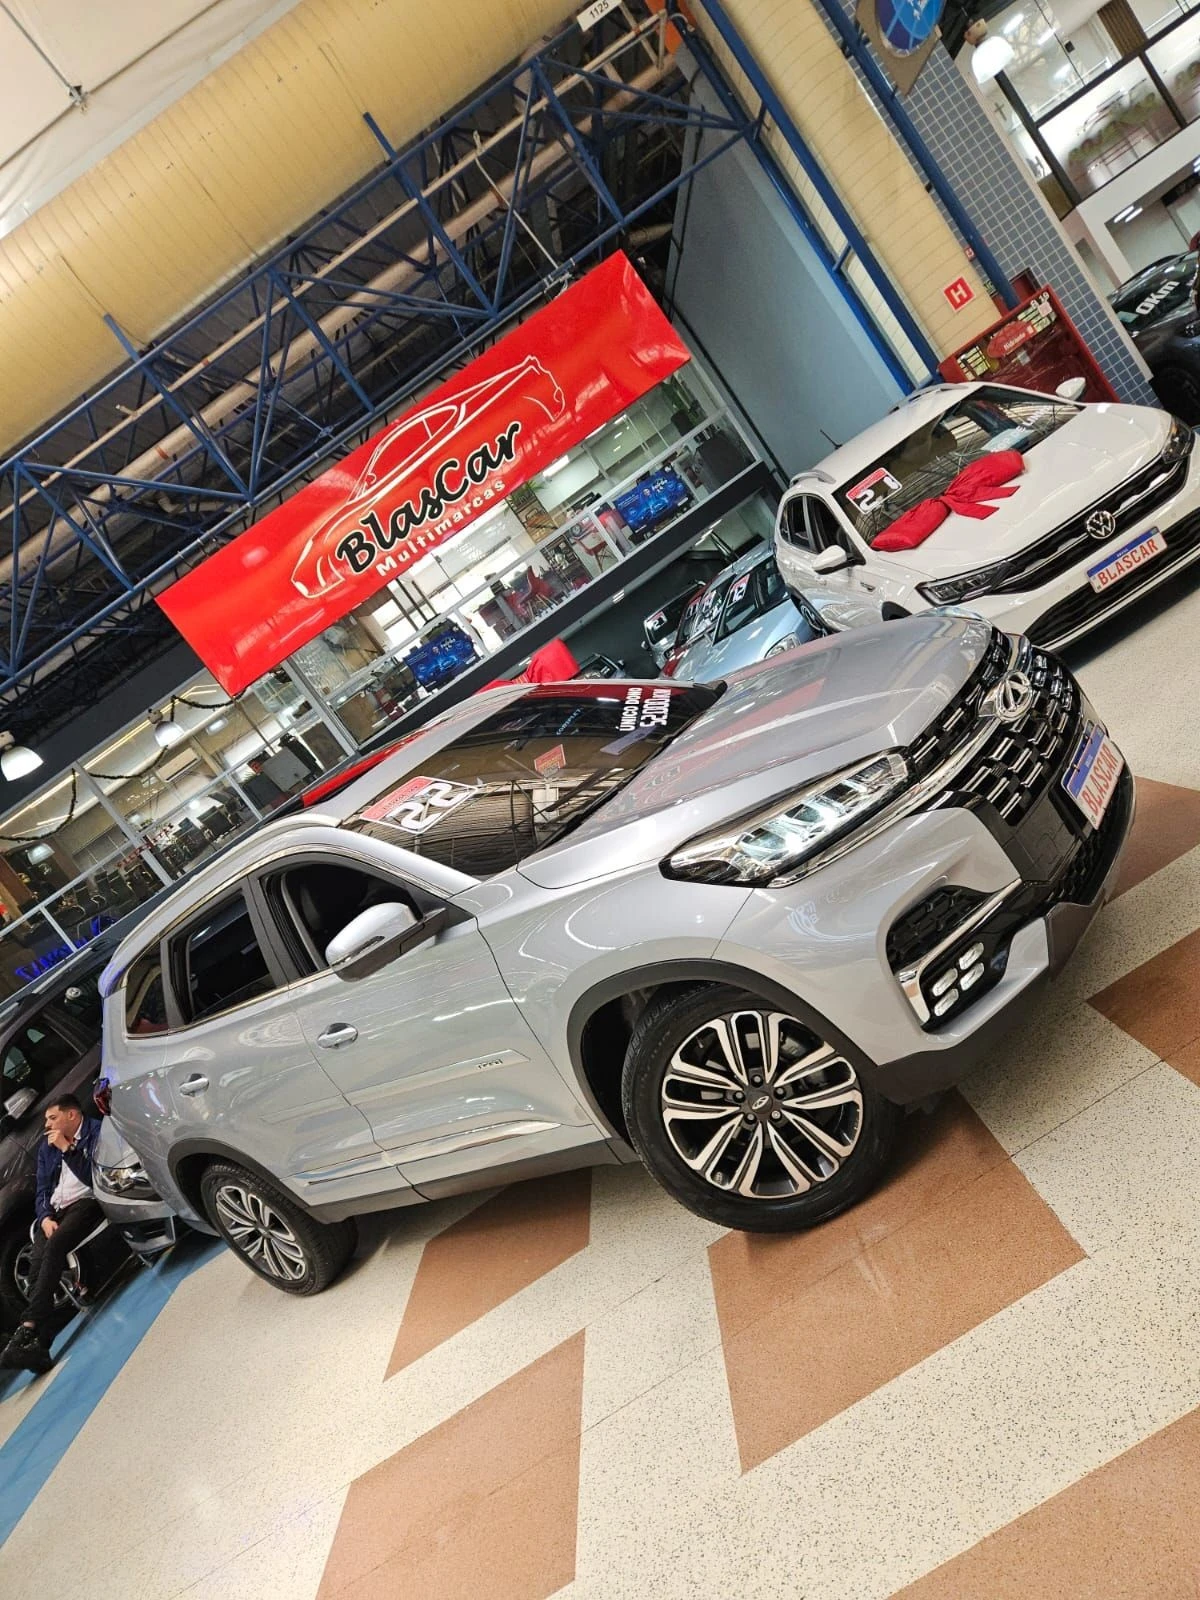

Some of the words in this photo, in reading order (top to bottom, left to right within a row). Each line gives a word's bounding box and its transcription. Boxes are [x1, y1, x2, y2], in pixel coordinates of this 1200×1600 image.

[590, 0, 609, 18] 1125
[950, 283, 968, 305] H
[335, 421, 522, 575] BlasCar
[375, 479, 507, 577] Multimarcas
[1097, 537, 1159, 588] BLASCAR
[616, 704, 639, 732] ÚNICO
[629, 687, 643, 706] DONO
[1082, 742, 1119, 816] BLASCAR
[386, 782, 466, 830] 22
